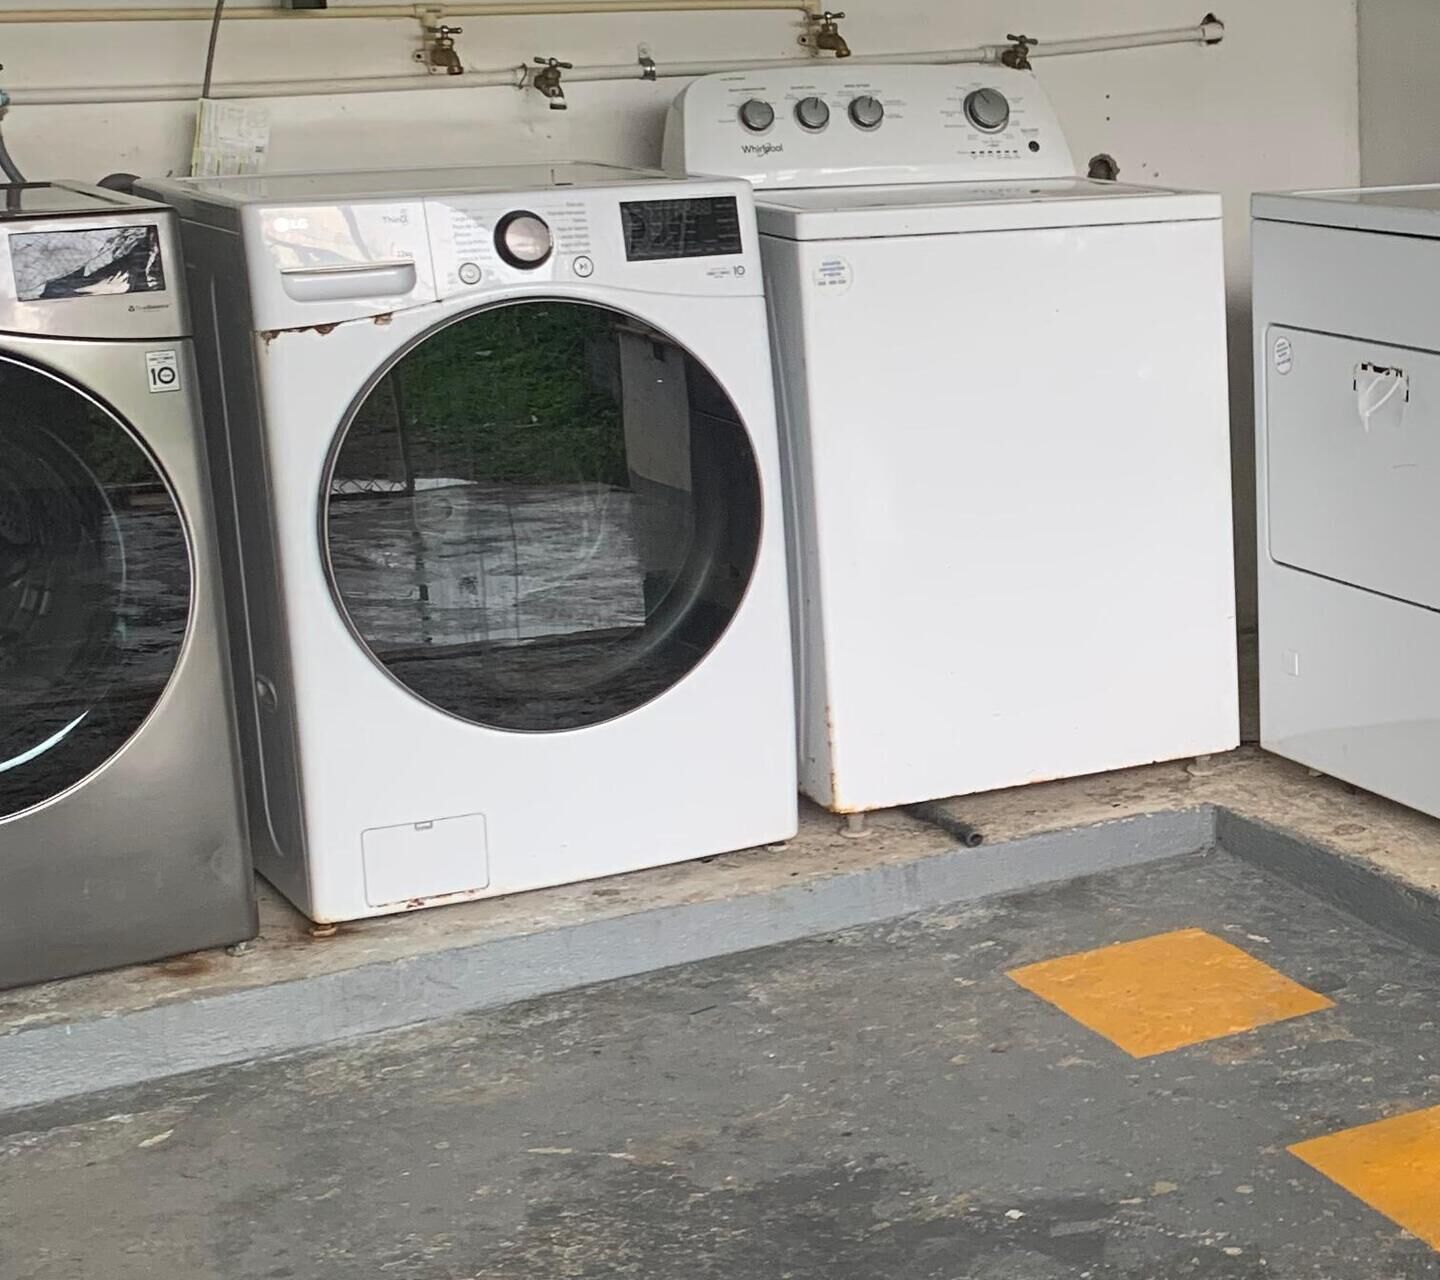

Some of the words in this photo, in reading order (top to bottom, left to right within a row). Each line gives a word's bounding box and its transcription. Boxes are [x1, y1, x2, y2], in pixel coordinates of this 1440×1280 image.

[741, 142, 784, 158] Whirlpool
[733, 265, 745, 276] 10
[151, 366, 176, 385] 10
